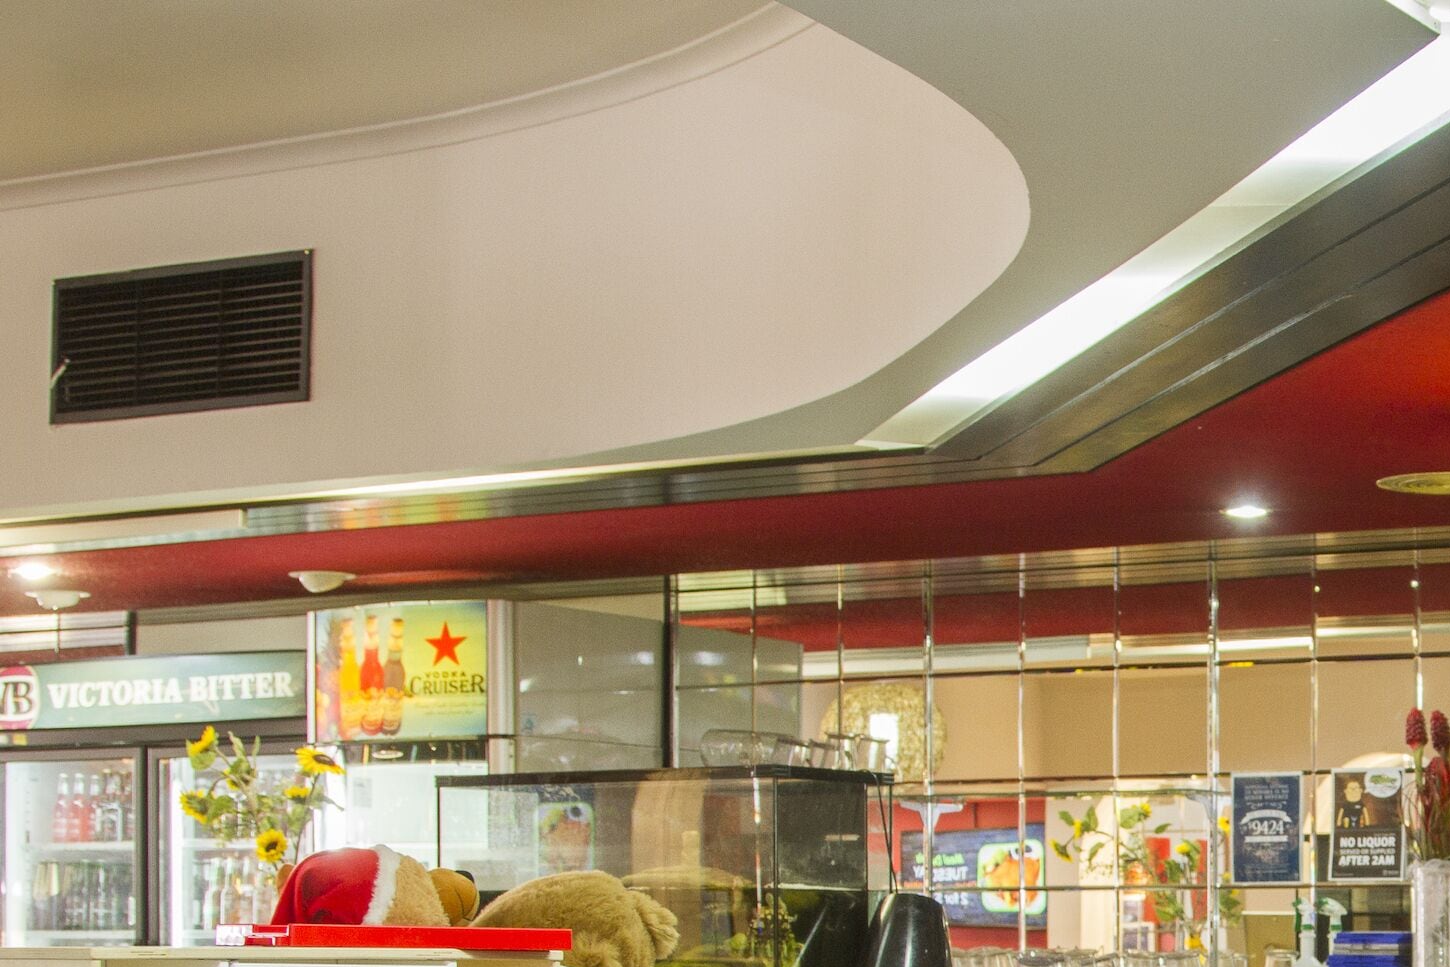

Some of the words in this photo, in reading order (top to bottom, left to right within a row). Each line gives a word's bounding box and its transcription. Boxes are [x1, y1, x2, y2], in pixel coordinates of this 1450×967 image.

[47, 676, 182, 709] VICTORIA
[189, 672, 295, 702] BITTER
[410, 674, 485, 695] CRUISER
[1340, 836, 1356, 848] NO
[1357, 836, 1396, 849] LIQUOR
[1338, 855, 1370, 866] AFTER
[1371, 855, 1395, 866] 2AM
